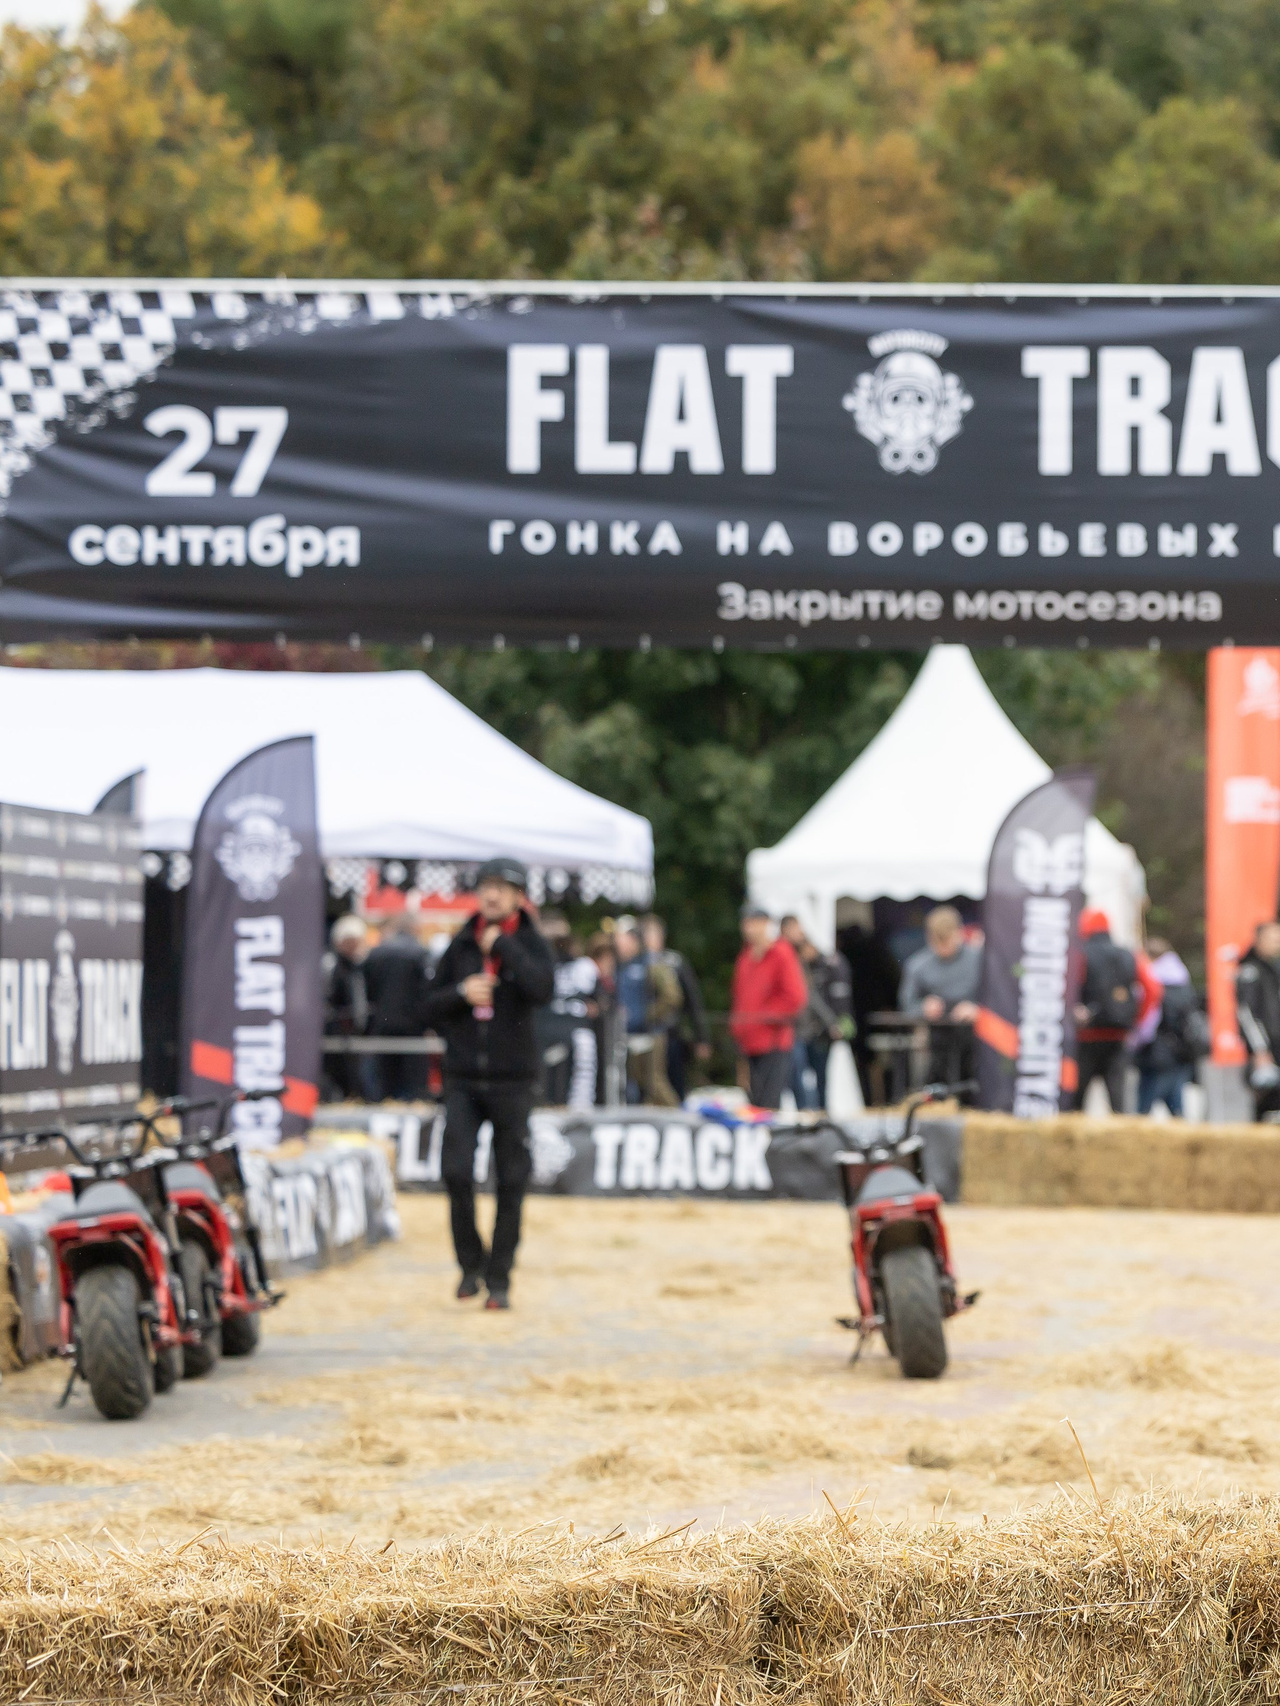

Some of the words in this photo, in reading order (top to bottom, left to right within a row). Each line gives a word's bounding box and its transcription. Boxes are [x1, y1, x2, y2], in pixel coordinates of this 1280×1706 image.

[507, 343, 795, 475] FLAT
[144, 405, 289, 499] 27
[68, 513, 362, 578] сентября
[488, 519, 683, 556] ГОНКА
[716, 520, 794, 557] НА
[826, 520, 1239, 559] ВОРОБЬЕВЫХ
[716, 581, 945, 627] Закрытие
[952, 589, 1224, 623] мотосезона
[233, 914, 287, 1016] FLAT
[591, 1123, 773, 1190] TRACK
